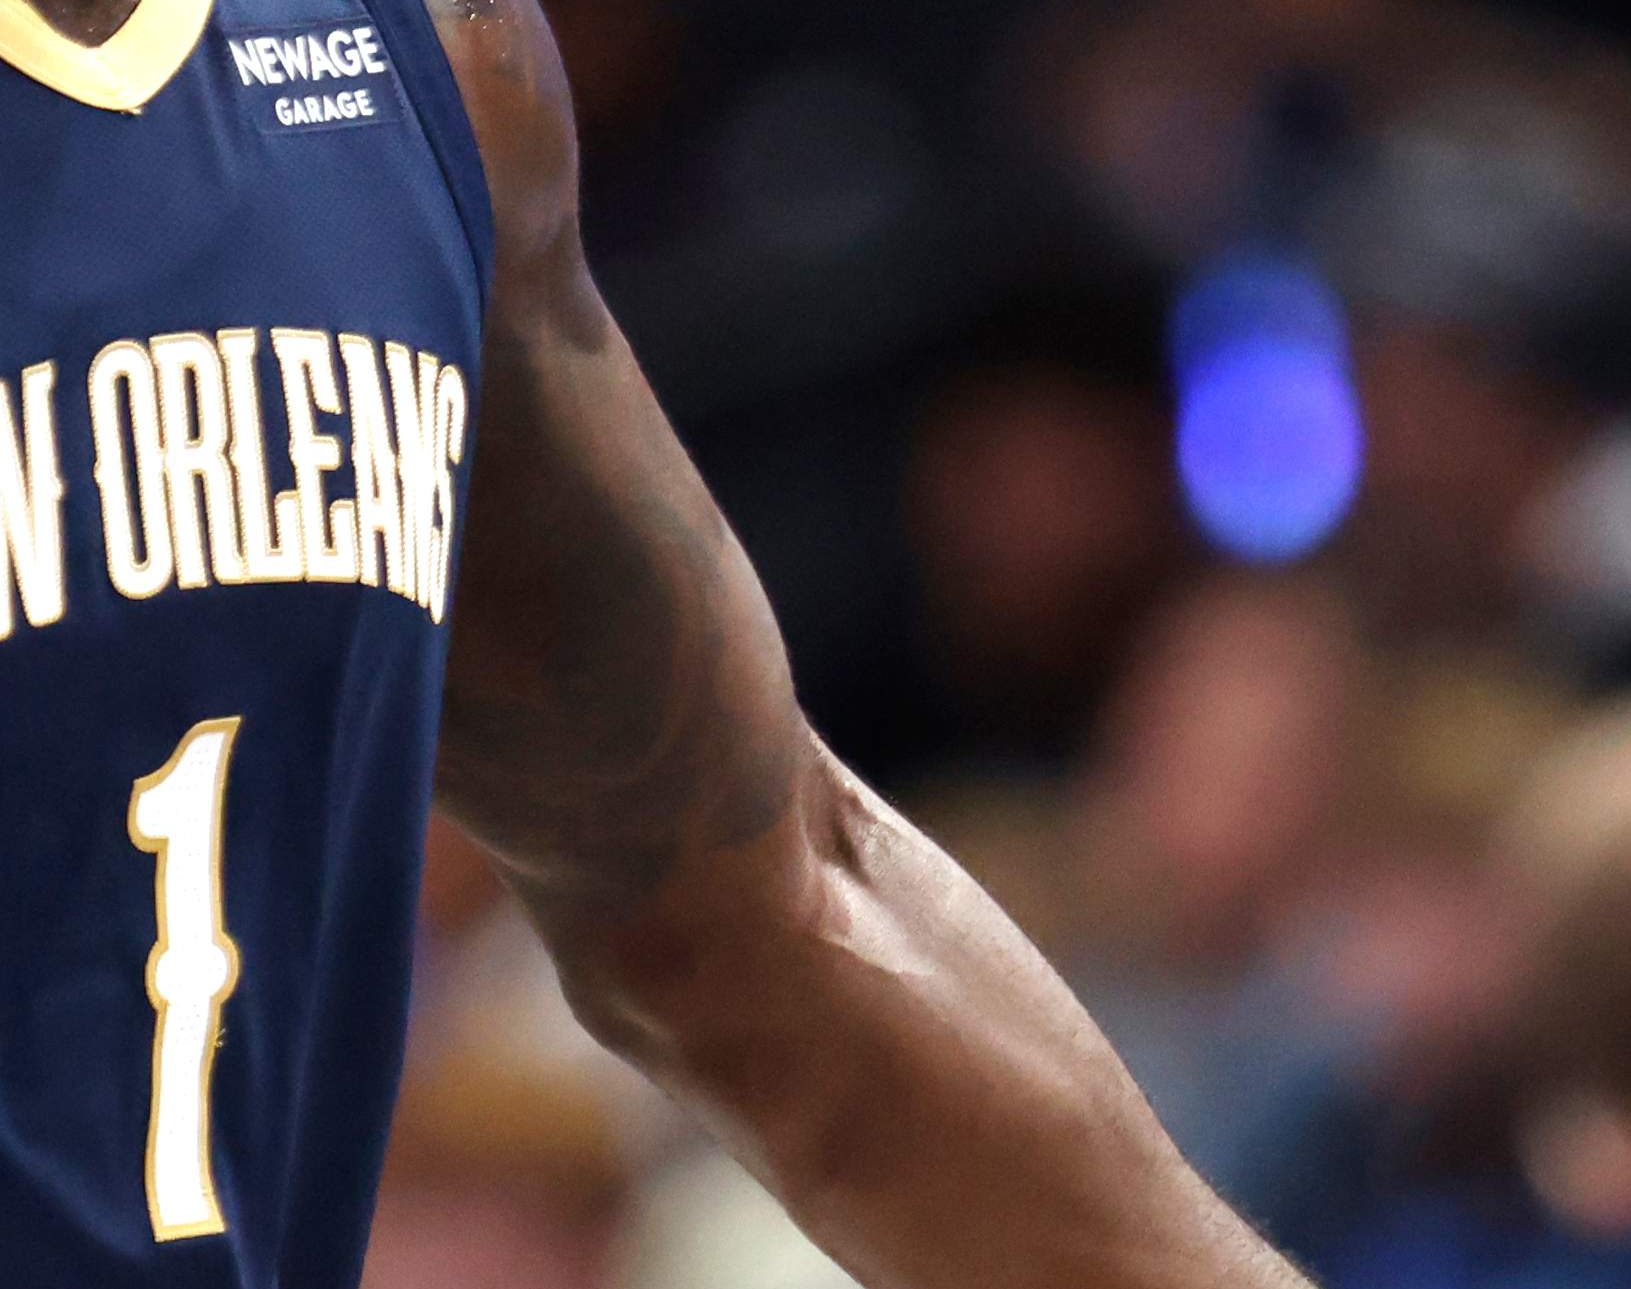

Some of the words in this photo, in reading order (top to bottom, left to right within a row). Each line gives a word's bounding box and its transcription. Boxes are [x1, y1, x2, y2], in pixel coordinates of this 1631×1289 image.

[228, 27, 385, 86] NEWAGE
[275, 89, 374, 126] GARAGE
[87, 327, 466, 624] ORLEANS
[127, 715, 241, 1241] 1
